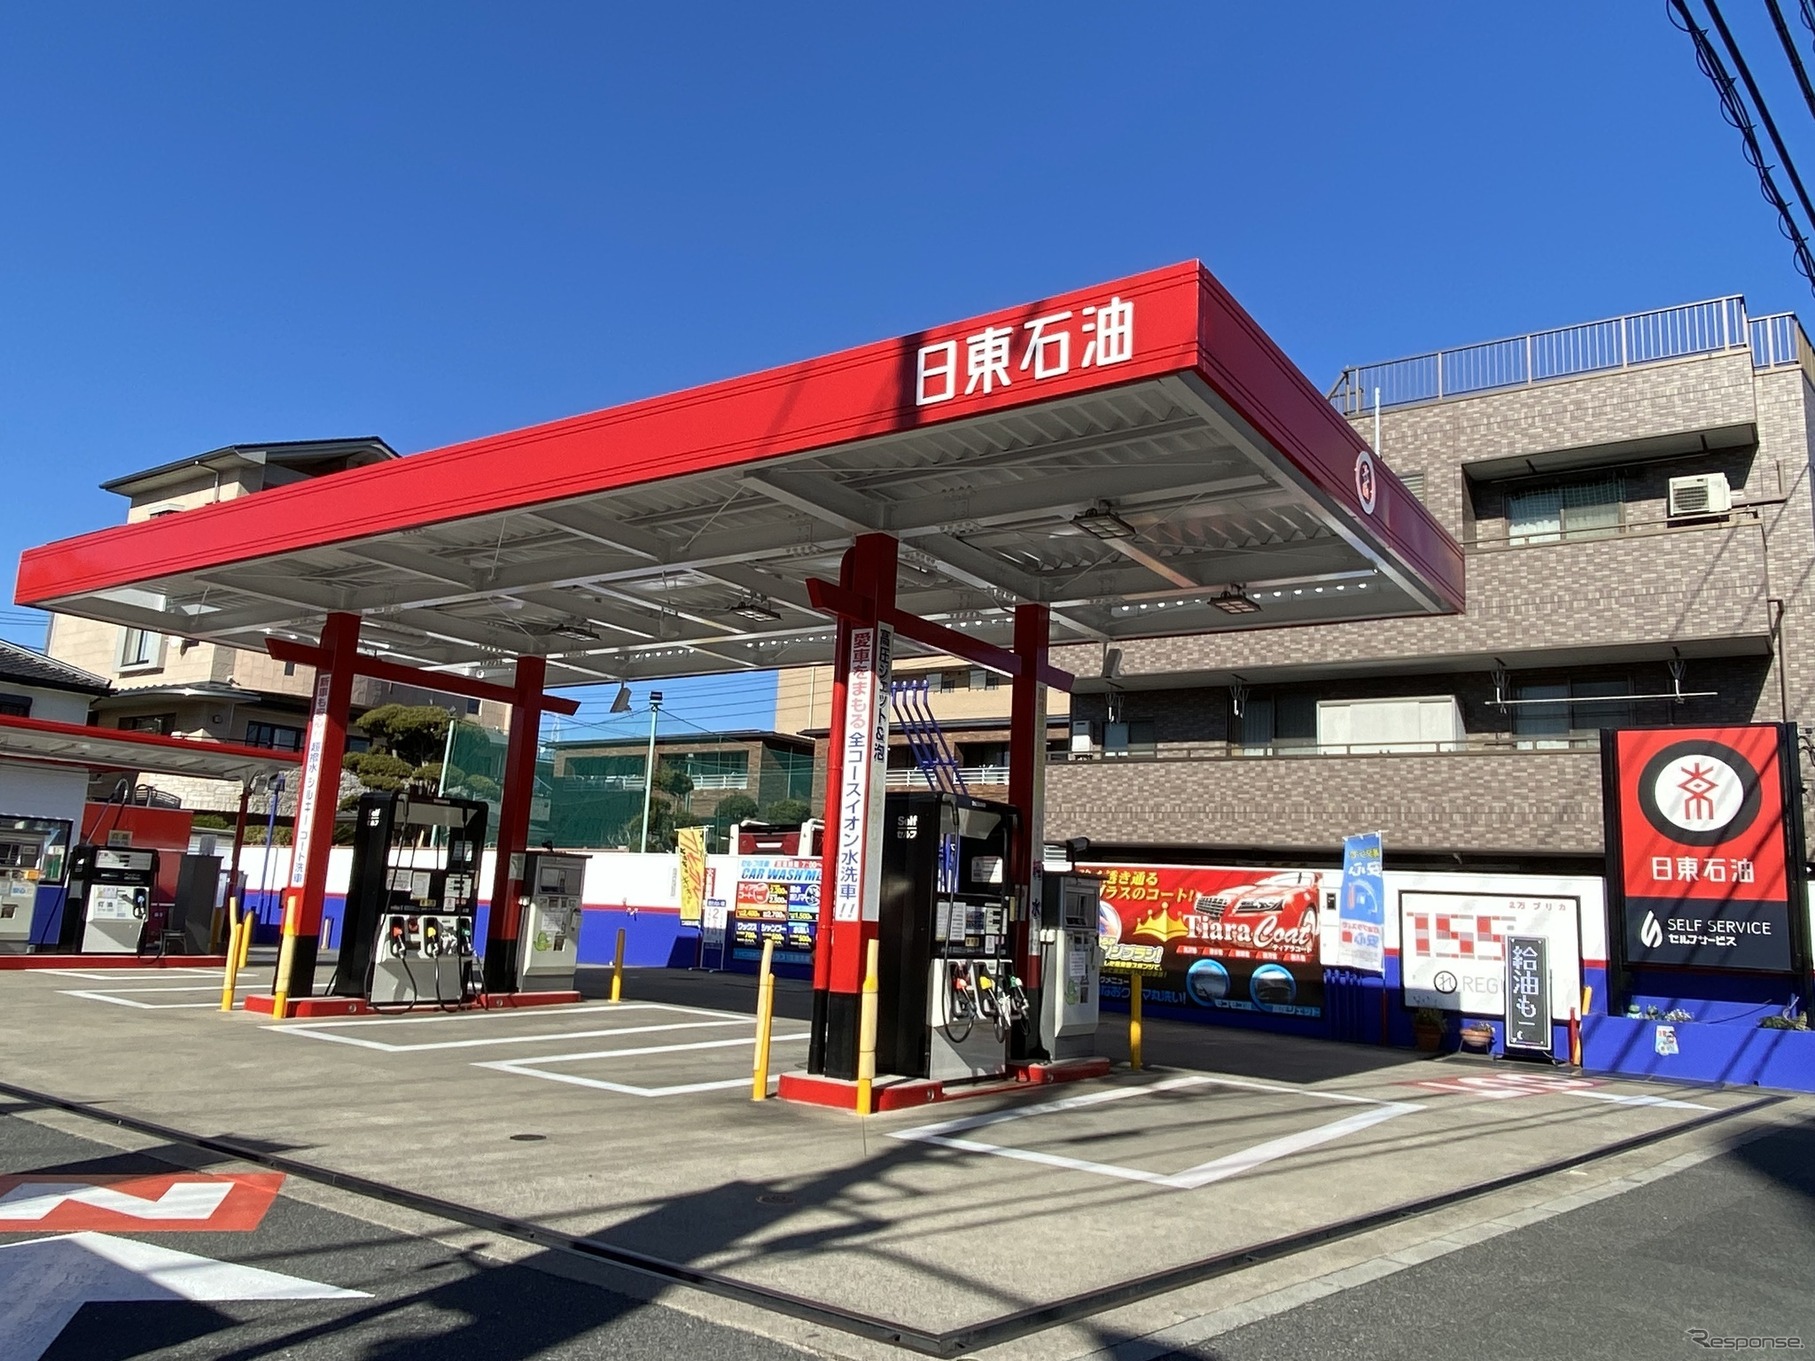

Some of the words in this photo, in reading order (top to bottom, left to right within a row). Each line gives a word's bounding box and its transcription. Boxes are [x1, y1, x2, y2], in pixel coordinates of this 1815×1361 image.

[916, 296, 1134, 406] 日東石油
[741, 868, 765, 880] CAR
[767, 869, 803, 881] WASH
[1104, 869, 1158, 886] 透き通る
[1651, 856, 1755, 883] 日東石油
[1183, 914, 1251, 942] Tiara
[1253, 915, 1312, 948] Coat
[1667, 918, 1703, 933] SELF
[1707, 920, 1772, 935] SERVICE
[1668, 933, 1737, 946] セルフサービス
[1272, 944, 1312, 953] ティアラコート
